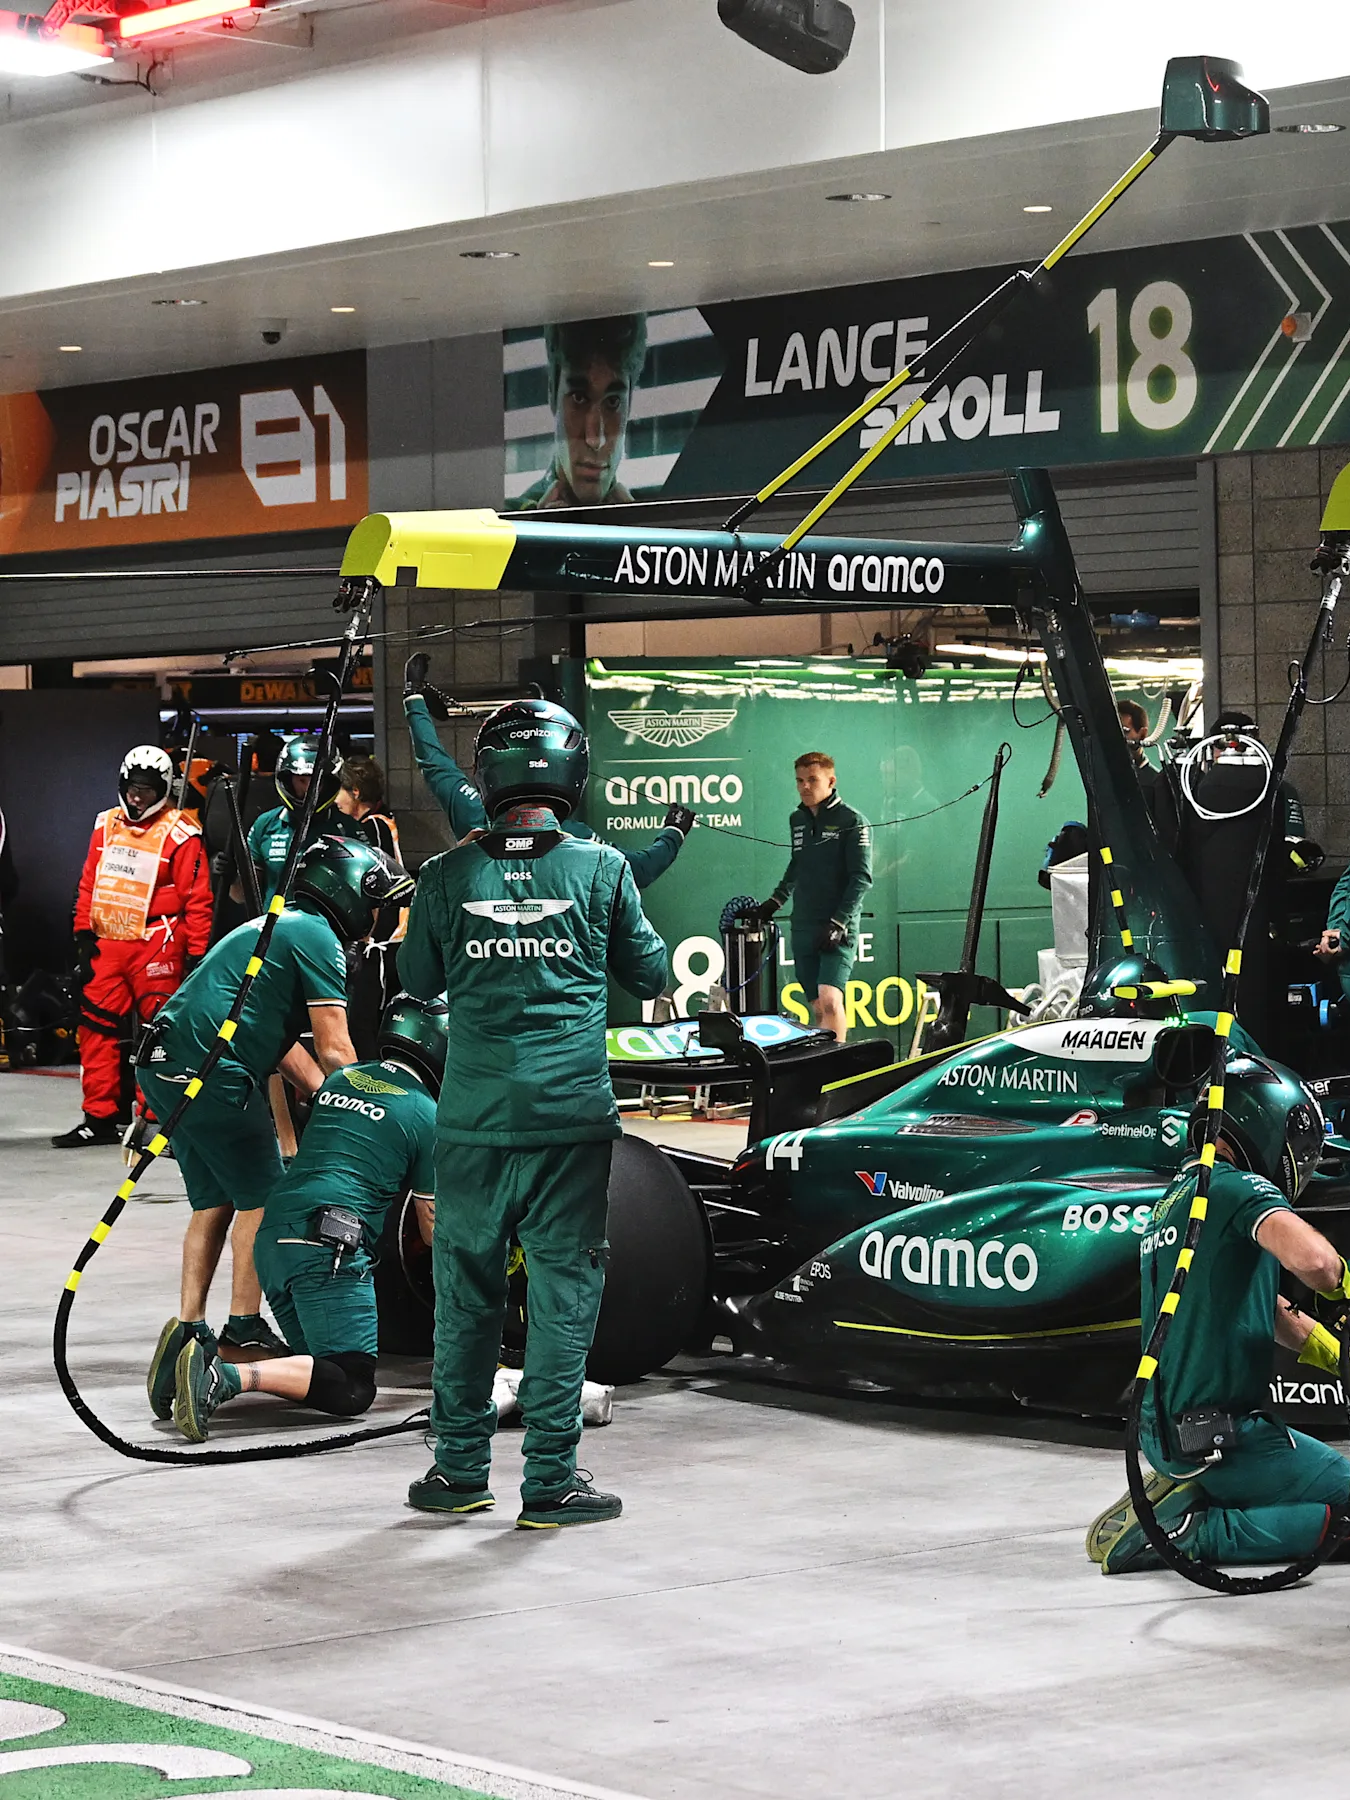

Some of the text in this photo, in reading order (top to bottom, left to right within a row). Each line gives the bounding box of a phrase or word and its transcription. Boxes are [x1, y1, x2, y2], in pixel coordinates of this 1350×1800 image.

[744, 316, 930, 397] LANCE
[1086, 280, 1197, 434] 18
[858, 369, 1060, 449] STROLL
[89, 402, 220, 466] OSCAR
[240, 384, 347, 506] 81
[54, 460, 190, 523] PIASTRI
[613, 544, 707, 586] ASTON
[827, 553, 945, 593] aramco
[646, 717, 700, 727] ASTON MARTIN
[605, 774, 743, 805] aramco
[606, 814, 666, 831] FORMULA
[706, 813, 742, 827] TEAM
[505, 837, 534, 850] OMP
[504, 871, 532, 881] BOSS
[494, 904, 543, 913] ASTON MARTIN
[465, 938, 574, 959] aramco
[380, 1061, 398, 1075] BOSS
[938, 1063, 1078, 1094] ASTON MARTIN
[318, 1091, 386, 1121] aramco
[766, 1127, 814, 1171] 14
[888, 1178, 944, 1203] Valvoline
[1062, 1204, 1151, 1235] BOSS
[859, 1229, 1039, 1292] aramco
